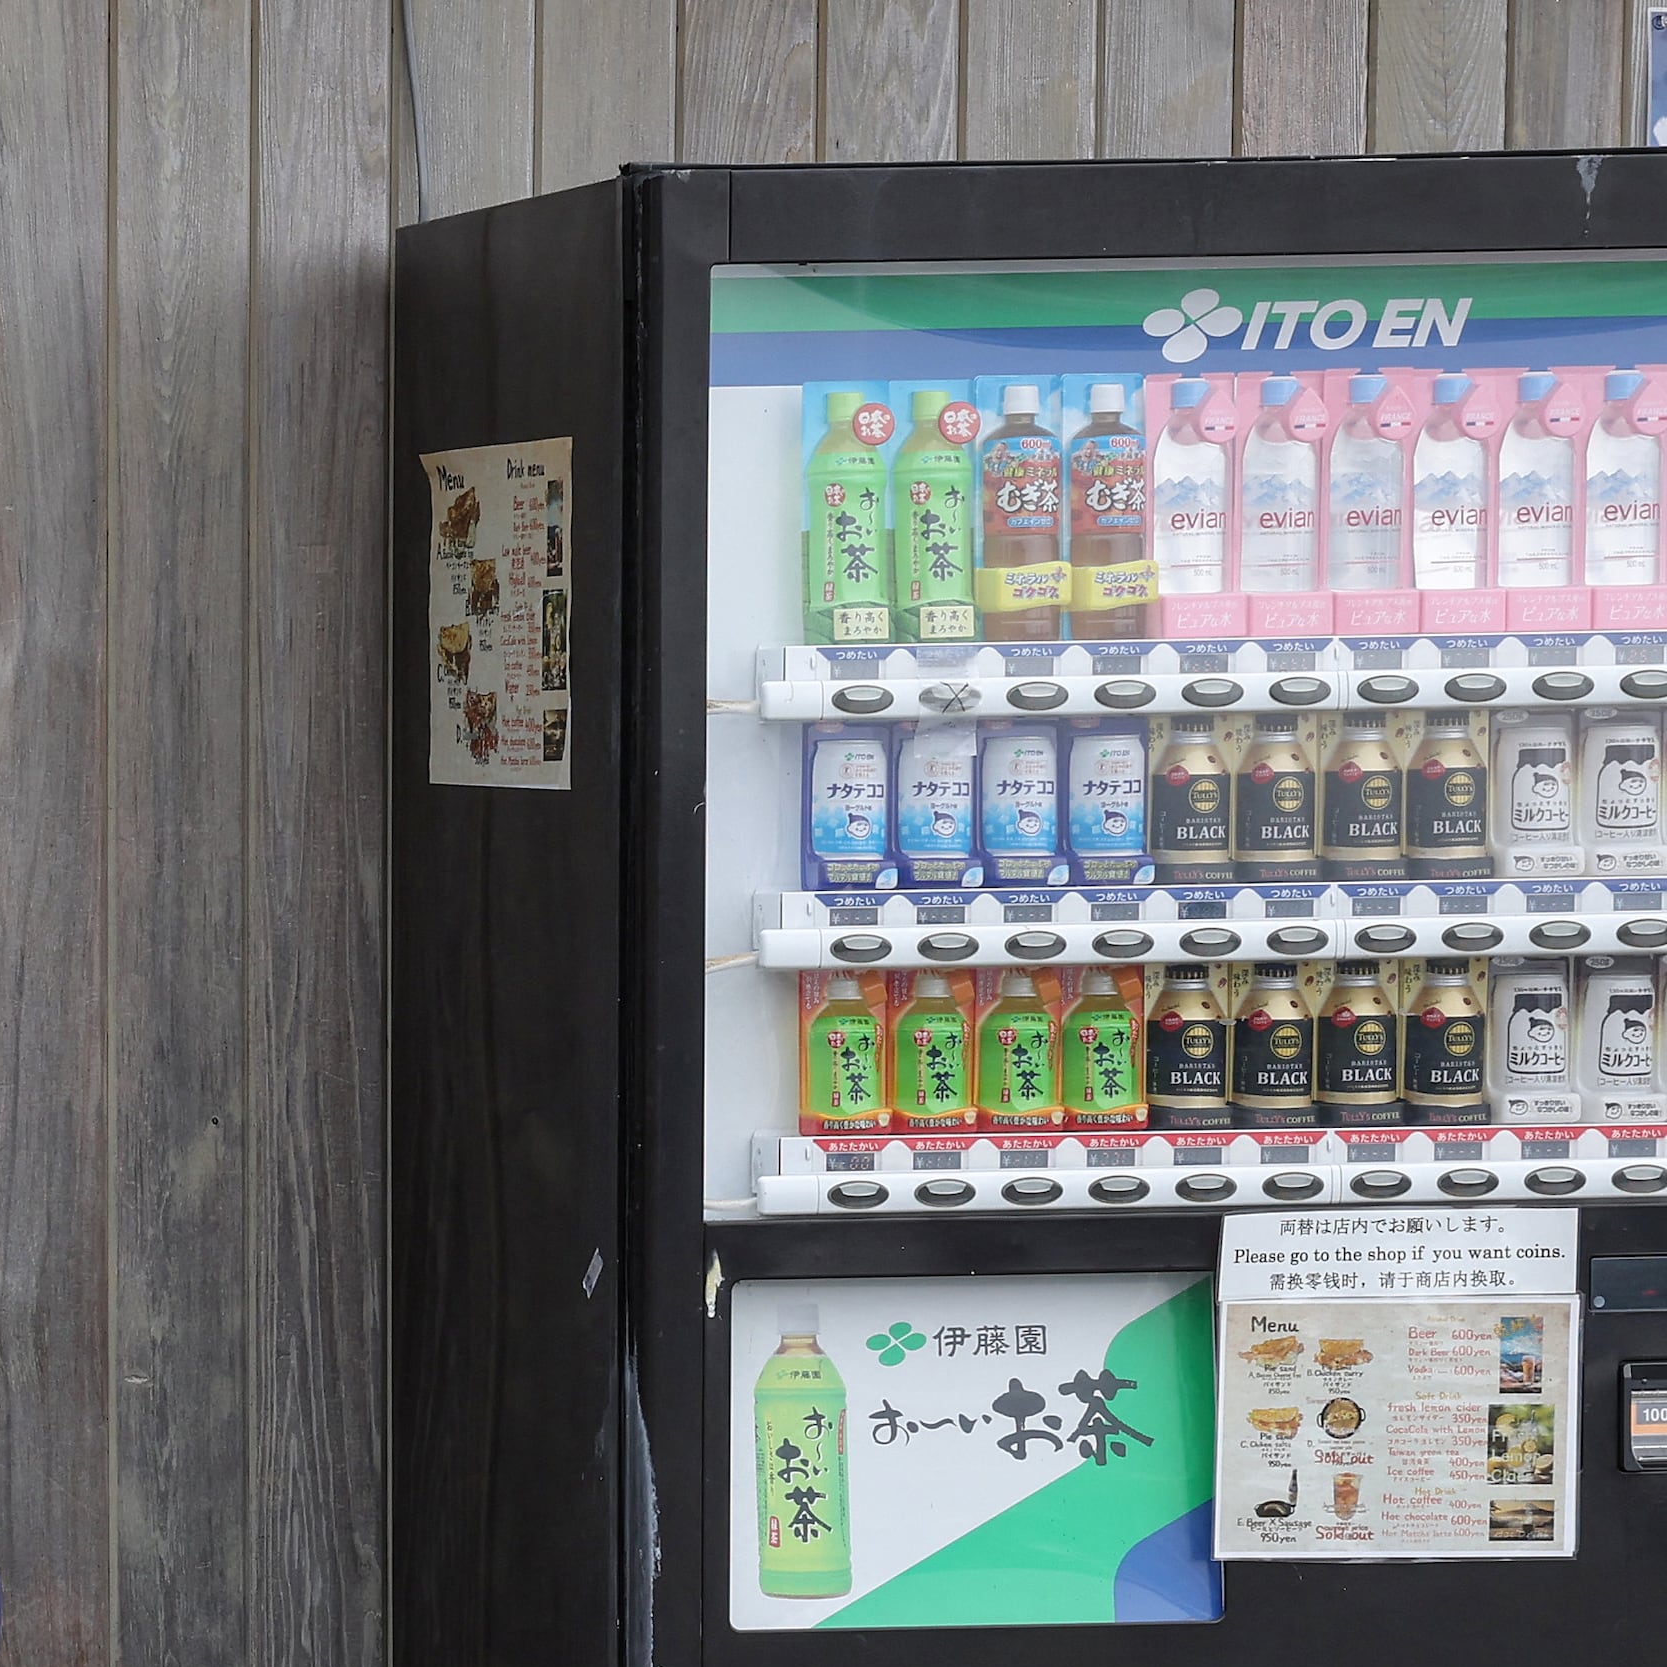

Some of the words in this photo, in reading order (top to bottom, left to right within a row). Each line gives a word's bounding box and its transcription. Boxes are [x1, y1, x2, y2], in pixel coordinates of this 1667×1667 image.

[1241, 299, 1367, 350] ITO
[1372, 298, 1473, 348] EN
[996, 480, 1059, 513] むぎ茶
[1346, 506, 1402, 527] evian
[1431, 506, 1487, 527] evian
[1517, 503, 1572, 523] evian
[1604, 501, 1660, 522] evian
[1171, 508, 1226, 530] evian
[1260, 508, 1314, 529] evian
[1358, 640, 1400, 650] つめたい
[1445, 638, 1488, 648] つめたい
[1533, 637, 1575, 646] つめたい
[1621, 635, 1663, 645] つめたい
[1098, 646, 1140, 655] つめたい
[1185, 643, 1227, 653] つめたい
[1273, 641, 1315, 651] つめたい
[835, 650, 877, 660] つめたい
[1011, 647, 1052, 657] つめたい
[1262, 825, 1310, 839] BLACK
[1349, 822, 1398, 837] BLACK
[1433, 820, 1482, 834] BLACK
[1177, 825, 1226, 840] BLACK
[1357, 886, 1399, 896] つめたい
[1445, 885, 1486, 895] つめたい
[1532, 883, 1574, 894] つめたい
[1619, 882, 1660, 892] つめたい
[1009, 893, 1050, 903] つめたい
[1096, 892, 1137, 902] つめたい
[1183, 891, 1224, 900] つめたい
[1271, 889, 1312, 898] つめたい
[834, 895, 876, 906] つめたい
[921, 895, 963, 905] つめたい
[1171, 1071, 1221, 1085] BLACK
[1257, 1071, 1307, 1084] BLACK
[1342, 1068, 1392, 1082] BLACK
[1431, 1068, 1480, 1083] BLACK
[1349, 1132, 1400, 1142] あたたかい
[1437, 1131, 1487, 1141] あたたかい
[1524, 1130, 1575, 1139] あたたかい
[1611, 1129, 1661, 1138] あたたかい
[1002, 1138, 1052, 1148] あたたかい
[1090, 1137, 1139, 1146] あたたかい
[1176, 1137, 1226, 1146] あたたかい
[1264, 1135, 1313, 1144] あたたかい
[828, 1142, 879, 1151] あたたかい
[916, 1140, 965, 1150] あたたかい
[1280, 1216, 1506, 1236] 両替は店内でお願いします。
[1234, 1248, 1285, 1263] Please
[1290, 1250, 1309, 1266] go
[1314, 1250, 1330, 1261] to
[1335, 1247, 1362, 1261] the
[1367, 1247, 1406, 1264] shop
[1412, 1245, 1425, 1260] if
[1432, 1247, 1461, 1263] you
[1469, 1245, 1511, 1260] want
[1517, 1244, 1565, 1259] coins.
[1251, 1316, 1299, 1332] Menu
[1408, 1327, 1437, 1339] Beer
[1452, 1330, 1492, 1341] 600yen
[933, 1324, 1047, 1356] 伊藤園
